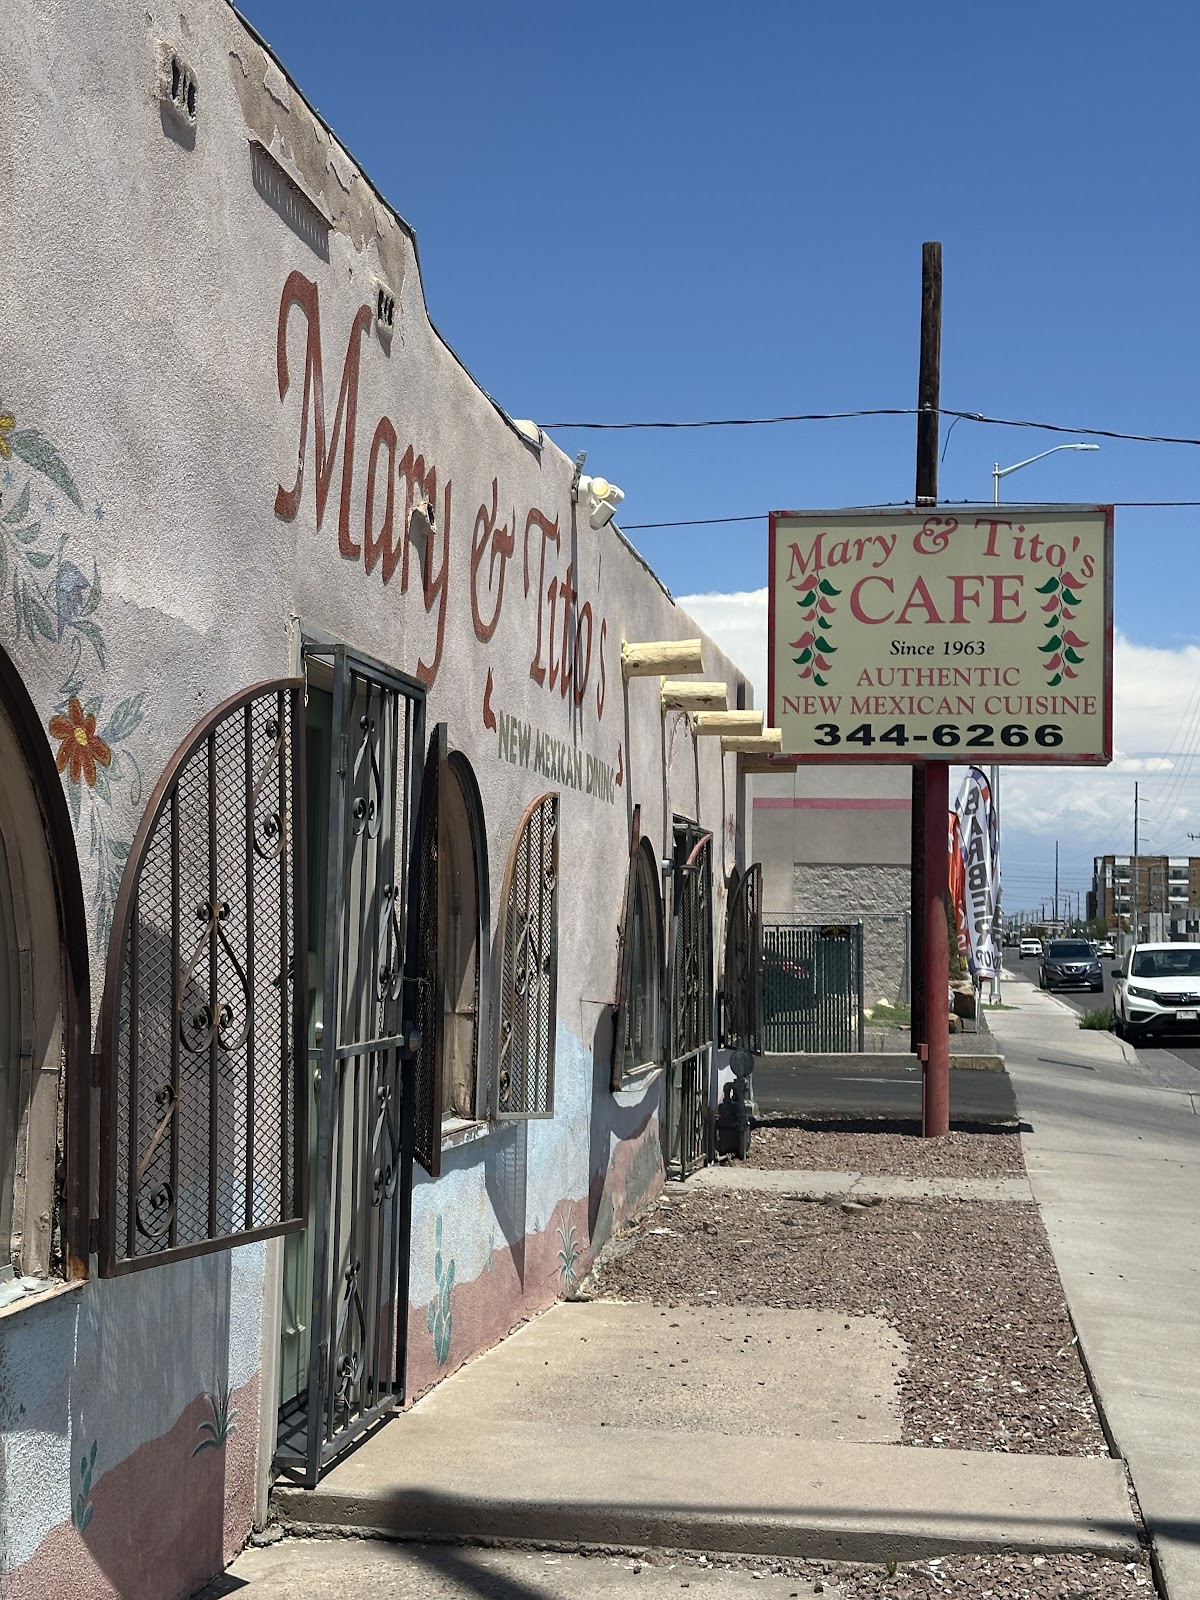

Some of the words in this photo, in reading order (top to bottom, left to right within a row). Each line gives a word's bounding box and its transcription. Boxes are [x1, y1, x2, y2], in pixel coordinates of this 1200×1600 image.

[274, 269, 451, 689] Mary
[470, 477, 515, 644] &
[786, 532, 897, 582] Mary
[913, 517, 959, 555] &
[975, 518, 1096, 578] Tito's
[850, 575, 1027, 625] CAFE
[889, 639, 935, 656] Since
[943, 639, 985, 657] 1963
[856, 667, 1021, 687] AUTHENTIC
[782, 695, 844, 715] NEW
[850, 695, 976, 715] MEXICAN
[984, 695, 1097, 715] CUISINE
[498, 709, 531, 769] NEW
[534, 728, 582, 791] MEXICAN
[813, 723, 1064, 747] 344-6266
